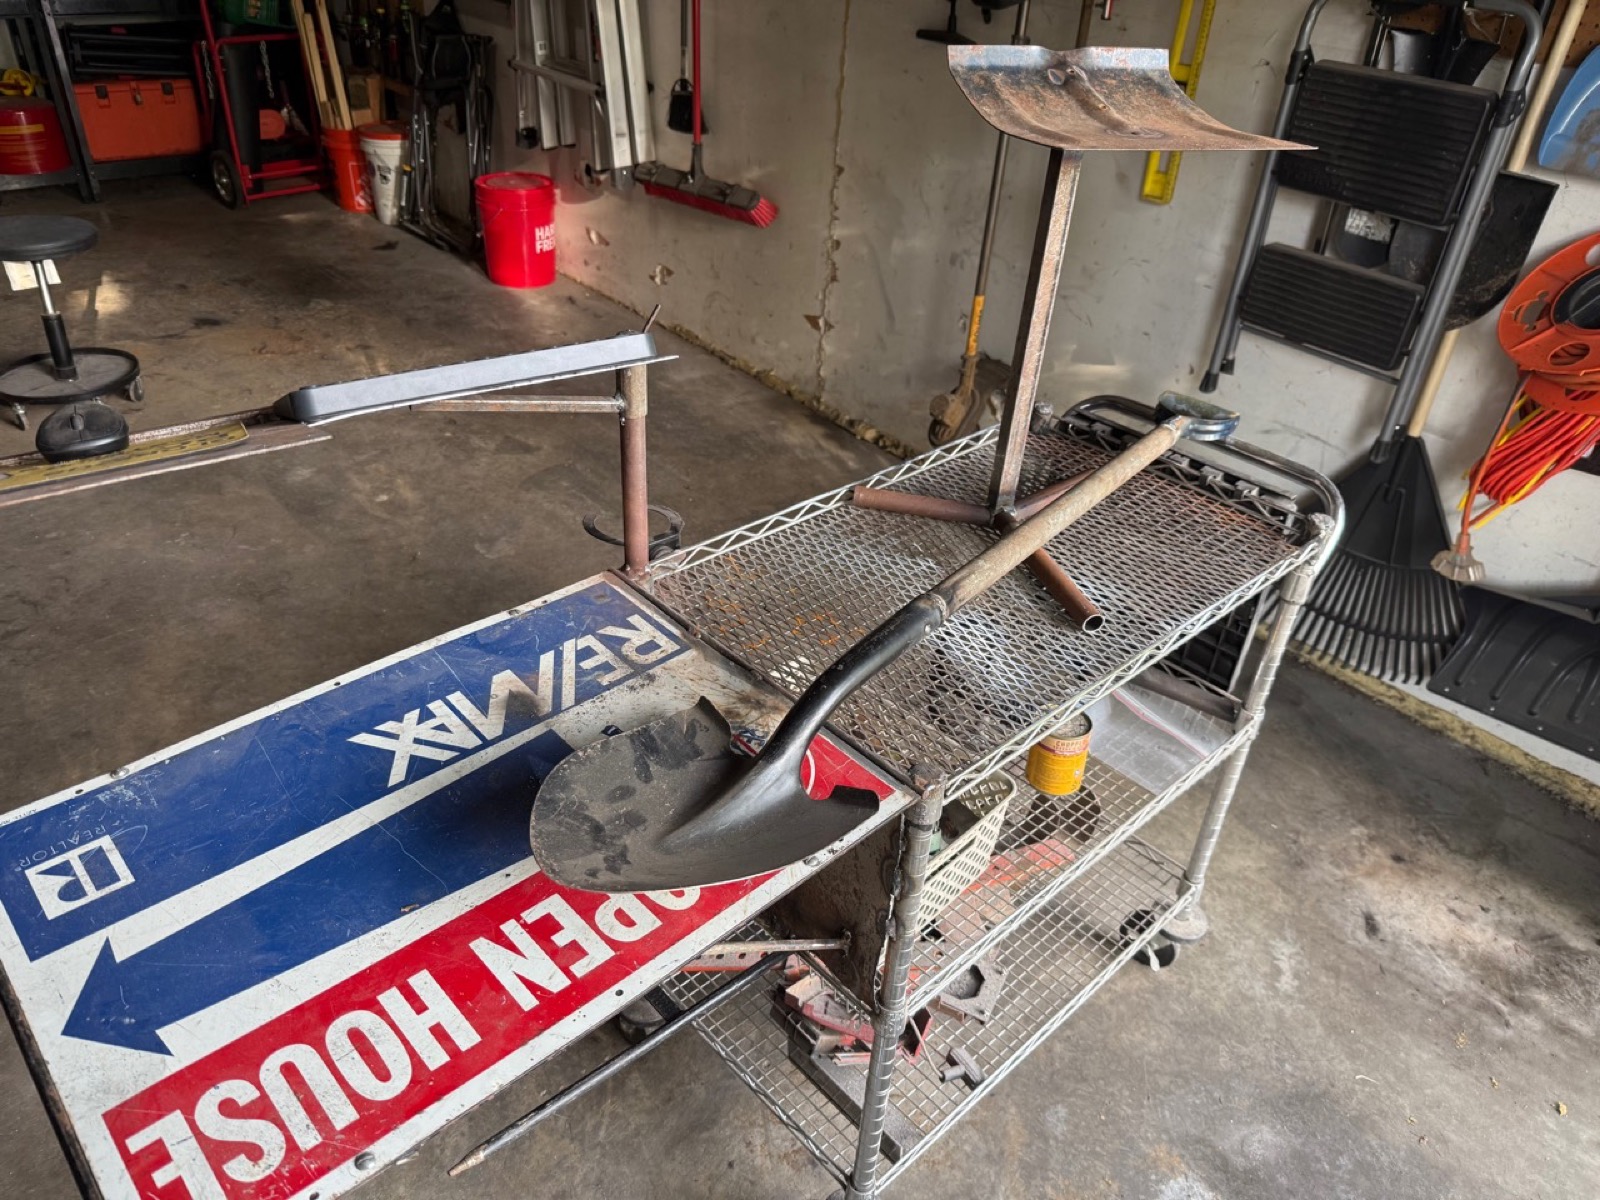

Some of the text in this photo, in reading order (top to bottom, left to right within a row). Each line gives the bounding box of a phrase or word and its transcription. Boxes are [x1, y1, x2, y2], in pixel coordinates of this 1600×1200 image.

[346, 614, 681, 788] RE/MAX
[18, 824, 106, 868] REALTOR
[468, 888, 702, 1012] PEN
